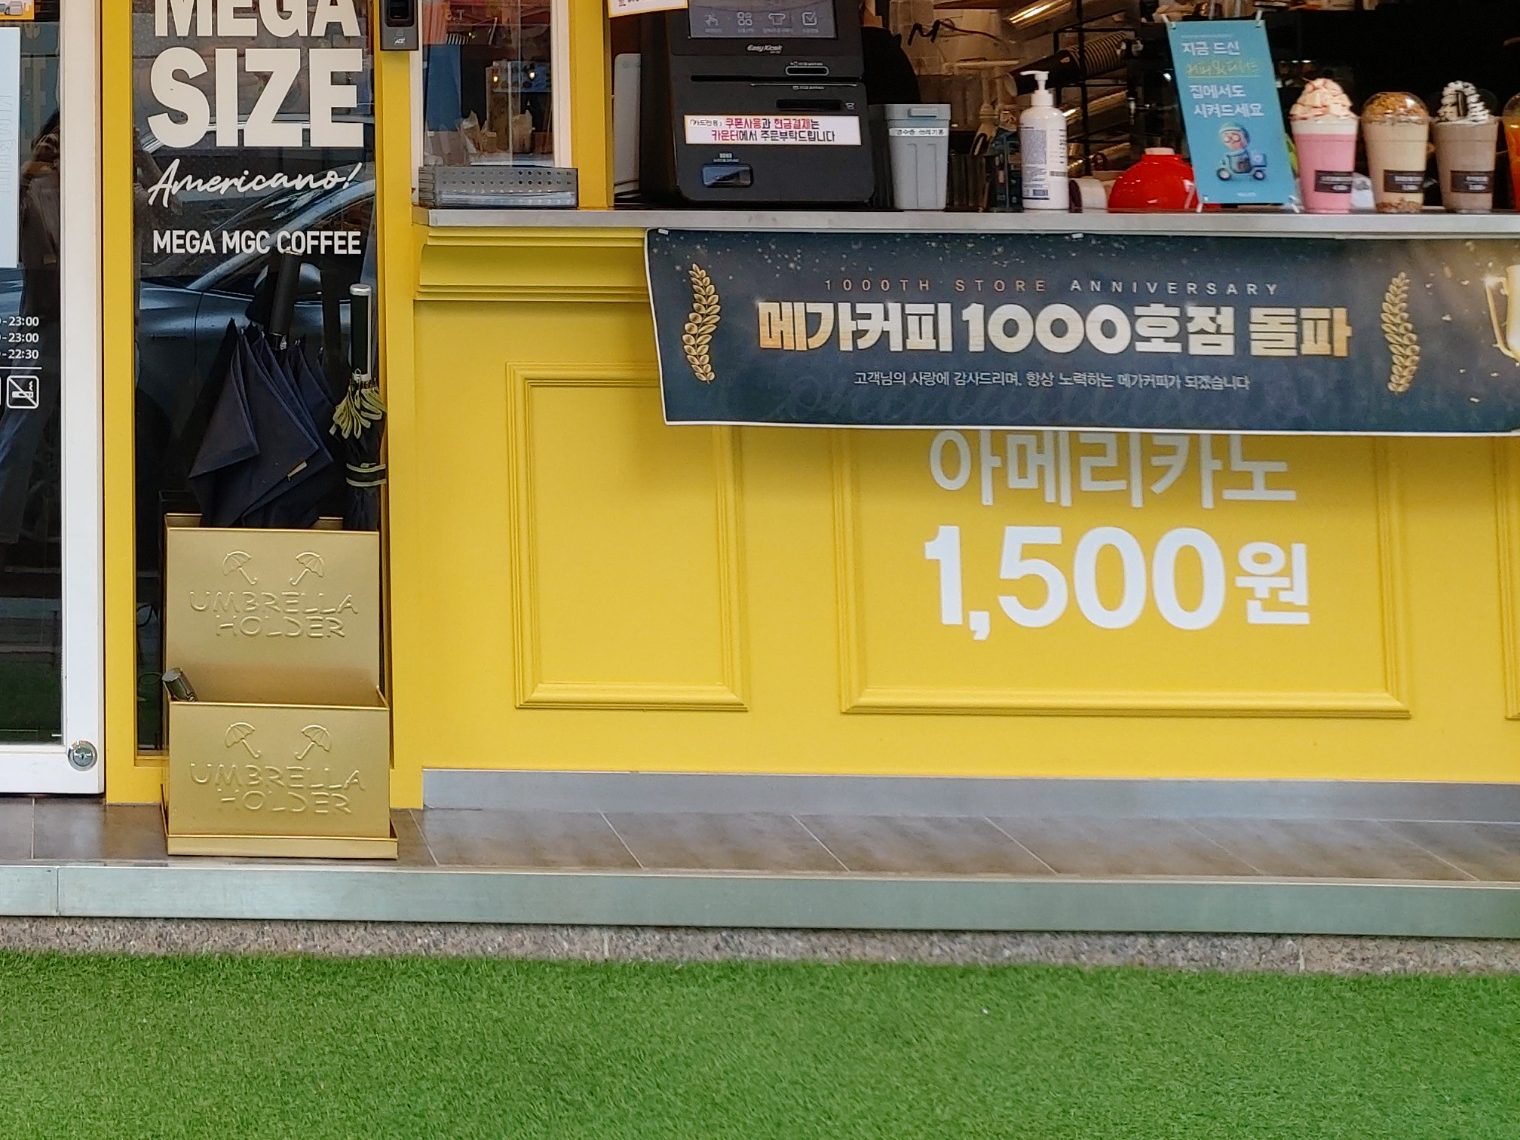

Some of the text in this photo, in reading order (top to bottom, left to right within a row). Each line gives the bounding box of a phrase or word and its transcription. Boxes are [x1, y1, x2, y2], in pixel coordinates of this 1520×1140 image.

[1181, 40, 1241, 56] 지금 드신
[147, 47, 364, 148] SIZE
[1189, 84, 1247, 99] 집에서도
[1194, 103, 1265, 118] 시켜드세요
[711, 129, 835, 142] 카운터에서 주문부탁드립니다
[725, 117, 771, 130] 쿠폰사용과
[774, 117, 820, 130] 현금결제는
[147, 158, 363, 208] Americano!
[153, 230, 362, 255] MEGA MGC COFFEE
[824, 279, 1278, 295] 1000TH STORE ANNIVERSARY
[758, 301, 1354, 357] 메가커피 1000호점 돌파
[853, 371, 907, 386] 고객님의
[910, 371, 949, 386] 사랑에
[1026, 371, 1054, 387] 항상
[1059, 371, 1114, 389] 노력하는
[1117, 372, 1180, 390] 메가커피가
[1184, 373, 1250, 391] 되겠습니다
[929, 429, 1297, 509] 아메리카노
[924, 525, 1311, 640] 1,500원
[189, 590, 359, 615] UMBRELLA
[216, 614, 346, 638] HOLDER
[189, 762, 366, 791] UMBRELLA
[216, 788, 352, 814] HOLDER
